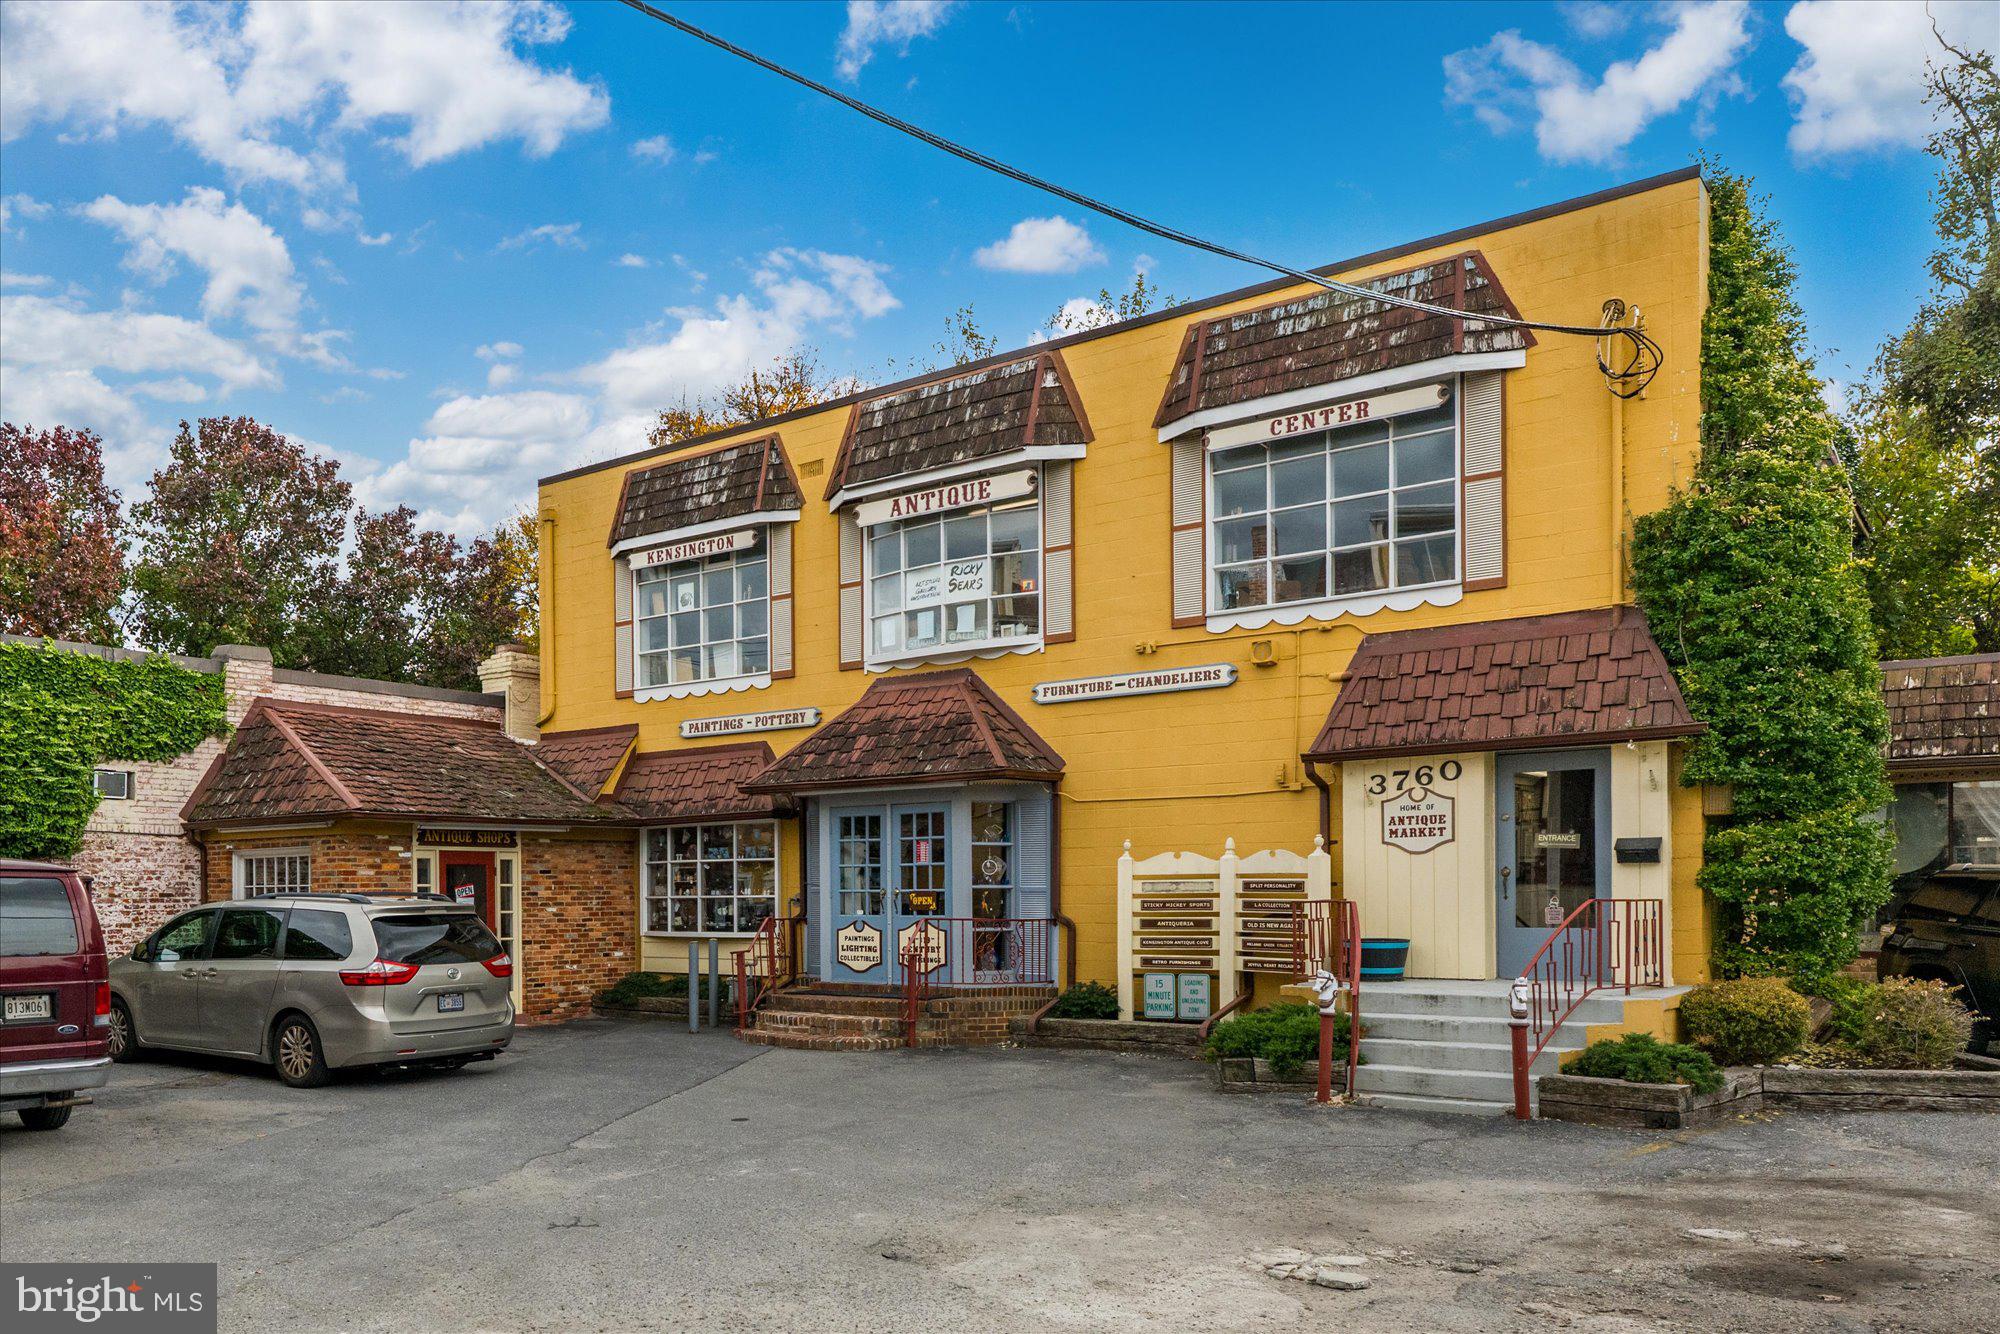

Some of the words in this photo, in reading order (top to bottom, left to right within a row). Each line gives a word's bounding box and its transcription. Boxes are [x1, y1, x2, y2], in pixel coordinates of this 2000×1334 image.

[1270, 401, 1370, 437] CENTER
[889, 479, 993, 518] ANTIQUE
[647, 535, 735, 564] KENSINGTON
[948, 578, 983, 594] SEARS
[1042, 681, 1113, 698] FURNITURE
[1127, 669, 1222, 689] CHANDELIERS
[688, 718, 744, 734] PAINTINGS
[755, 712, 807, 727] POTTERY
[1368, 760, 1462, 795] 3760
[1388, 814, 1447, 826] ANTIQUE
[424, 829, 472, 843] ANTIQUE
[477, 831, 511, 844] SHOPS
[1388, 827, 1447, 838] MARKET
[1538, 834, 1577, 842] ENTRANCE
[456, 886, 474, 897] OPEN
[912, 896, 933, 905] OPEN
[841, 945, 878, 953] LIGHTING
[1155, 979, 1164, 988] 15
[1184, 979, 1204, 987] LOADING
[1147, 991, 1171, 1001] MINUTE
[1189, 988, 1199, 996] AND
[1146, 1002, 1173, 1013] PARKING
[1181, 998, 1207, 1006] UNLOADING
[1187, 1006, 1200, 1014] ZONE
